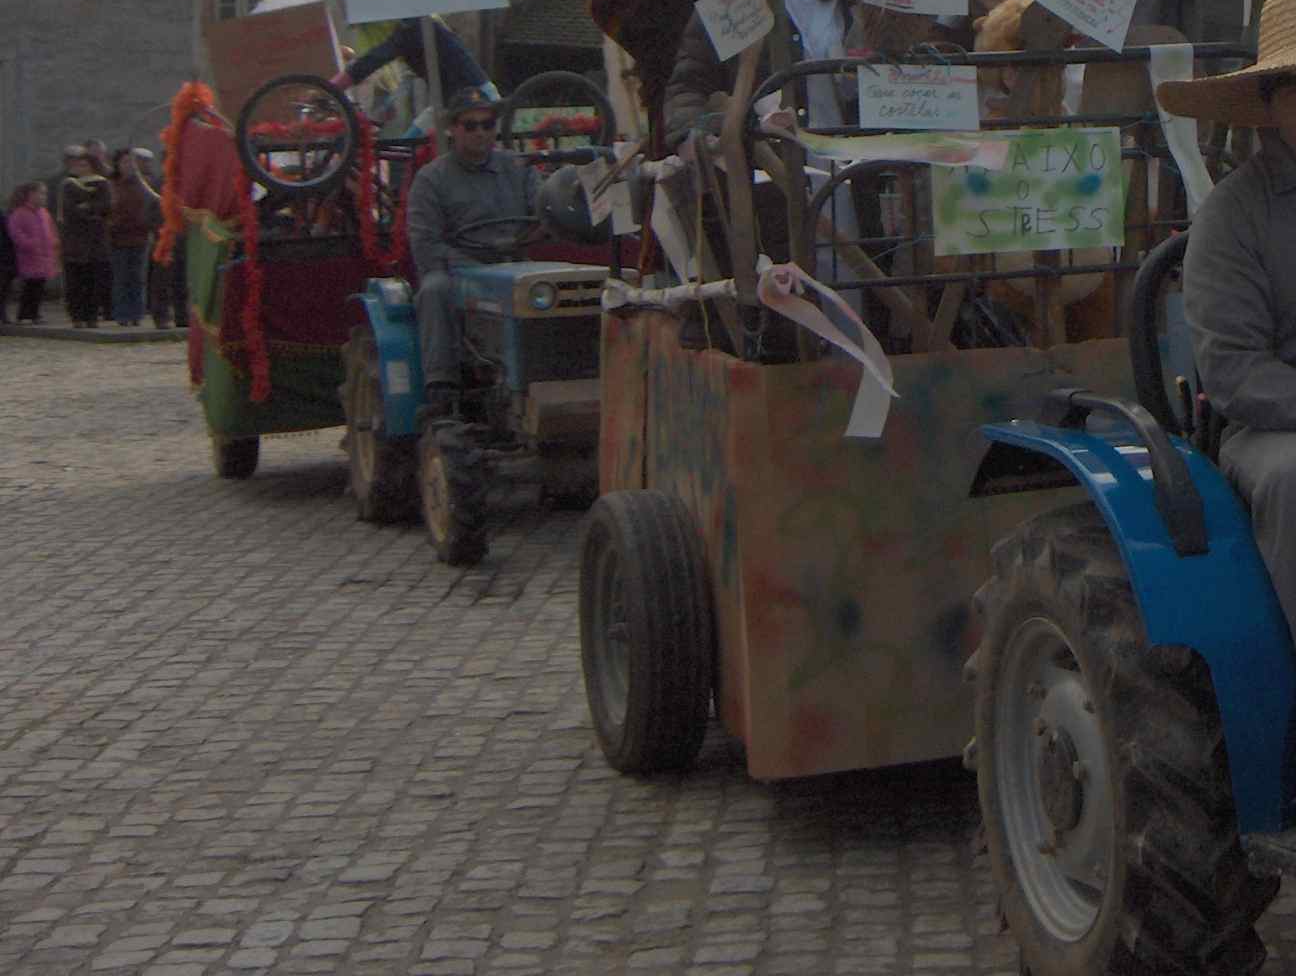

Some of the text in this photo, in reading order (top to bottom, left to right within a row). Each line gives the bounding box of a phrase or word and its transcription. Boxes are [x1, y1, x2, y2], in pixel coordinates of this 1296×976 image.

[946, 142, 1106, 175] AIXO
[1015, 179, 1030, 201] O
[966, 206, 1110, 239] STRESS
